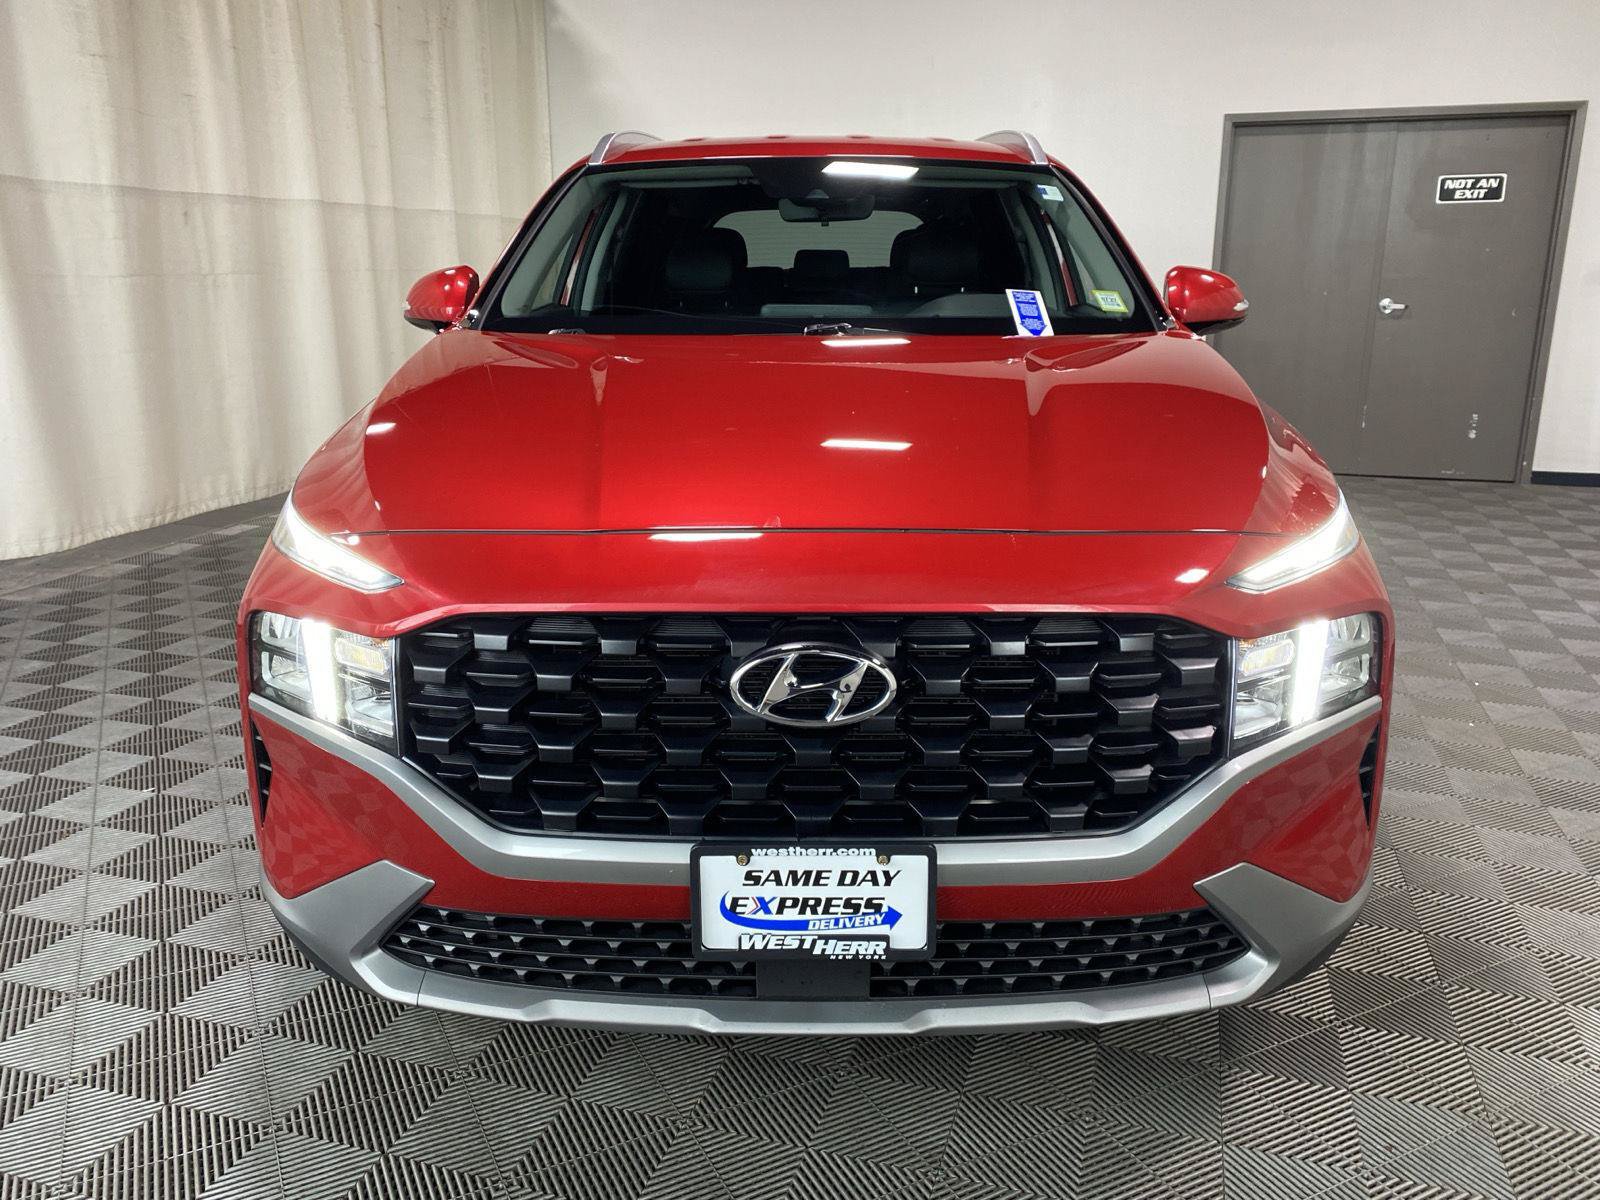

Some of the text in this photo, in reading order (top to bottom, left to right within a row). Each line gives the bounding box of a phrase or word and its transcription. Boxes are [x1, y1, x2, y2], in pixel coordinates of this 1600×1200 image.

[1444, 178, 1500, 189] NOT AN
[1454, 189, 1488, 199] EXIT
[751, 847, 876, 857] westherr.com
[742, 869, 902, 887] SAME DAY
[729, 896, 886, 916] EXPRESS
[807, 913, 886, 931] DELIVERY
